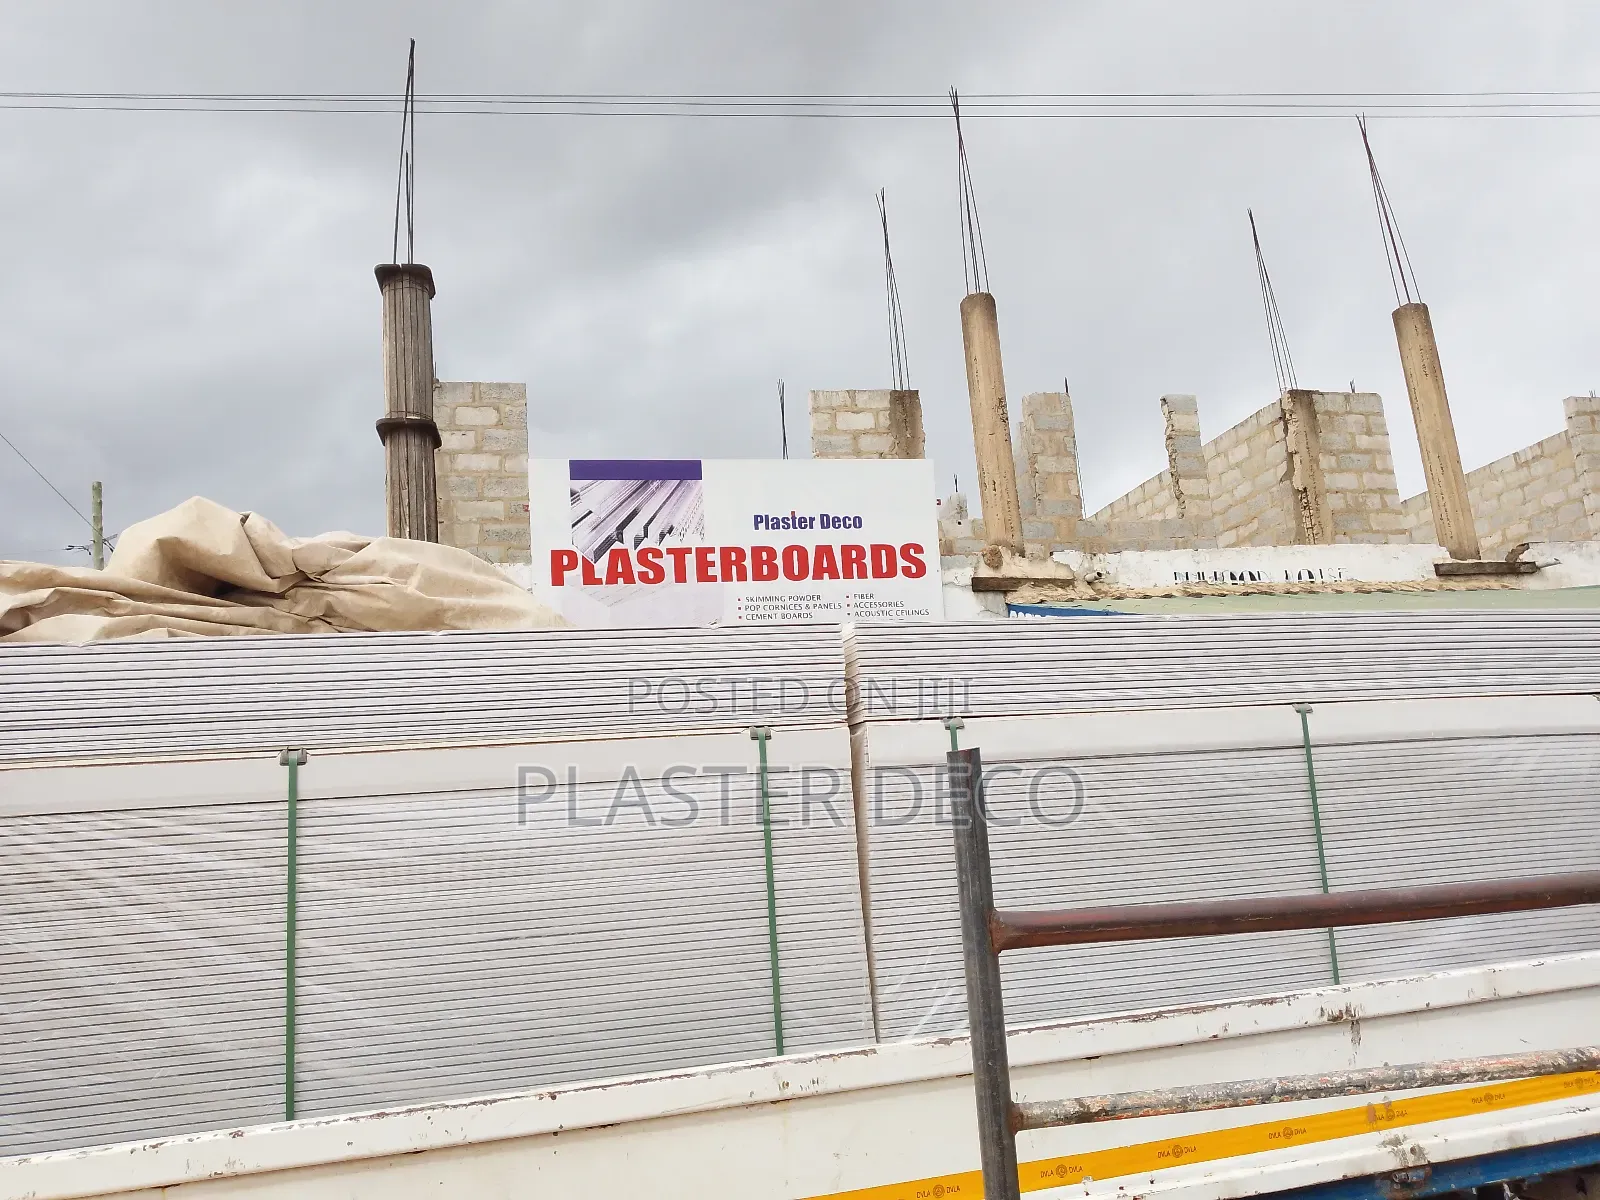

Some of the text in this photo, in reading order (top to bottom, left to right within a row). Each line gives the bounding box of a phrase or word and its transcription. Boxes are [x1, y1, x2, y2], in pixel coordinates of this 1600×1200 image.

[753, 511, 863, 531] Plaster Deco
[550, 543, 927, 587] PLASTERBOARDS
[745, 594, 821, 603] SKIMMING POWDER
[744, 604, 760, 612] POP
[763, 603, 803, 611] CORNICES
[813, 602, 842, 610] PANELS
[895, 609, 930, 617] CEILINGS
[745, 612, 813, 621] CEMENT BOARDS
[1268, 1127, 1307, 1140] DVLA DVLA
[1157, 1145, 1198, 1159] DVLA DVLA
[1040, 1165, 1084, 1179] DVLA DVLA
[916, 1185, 961, 1199] DVLA DVLA
